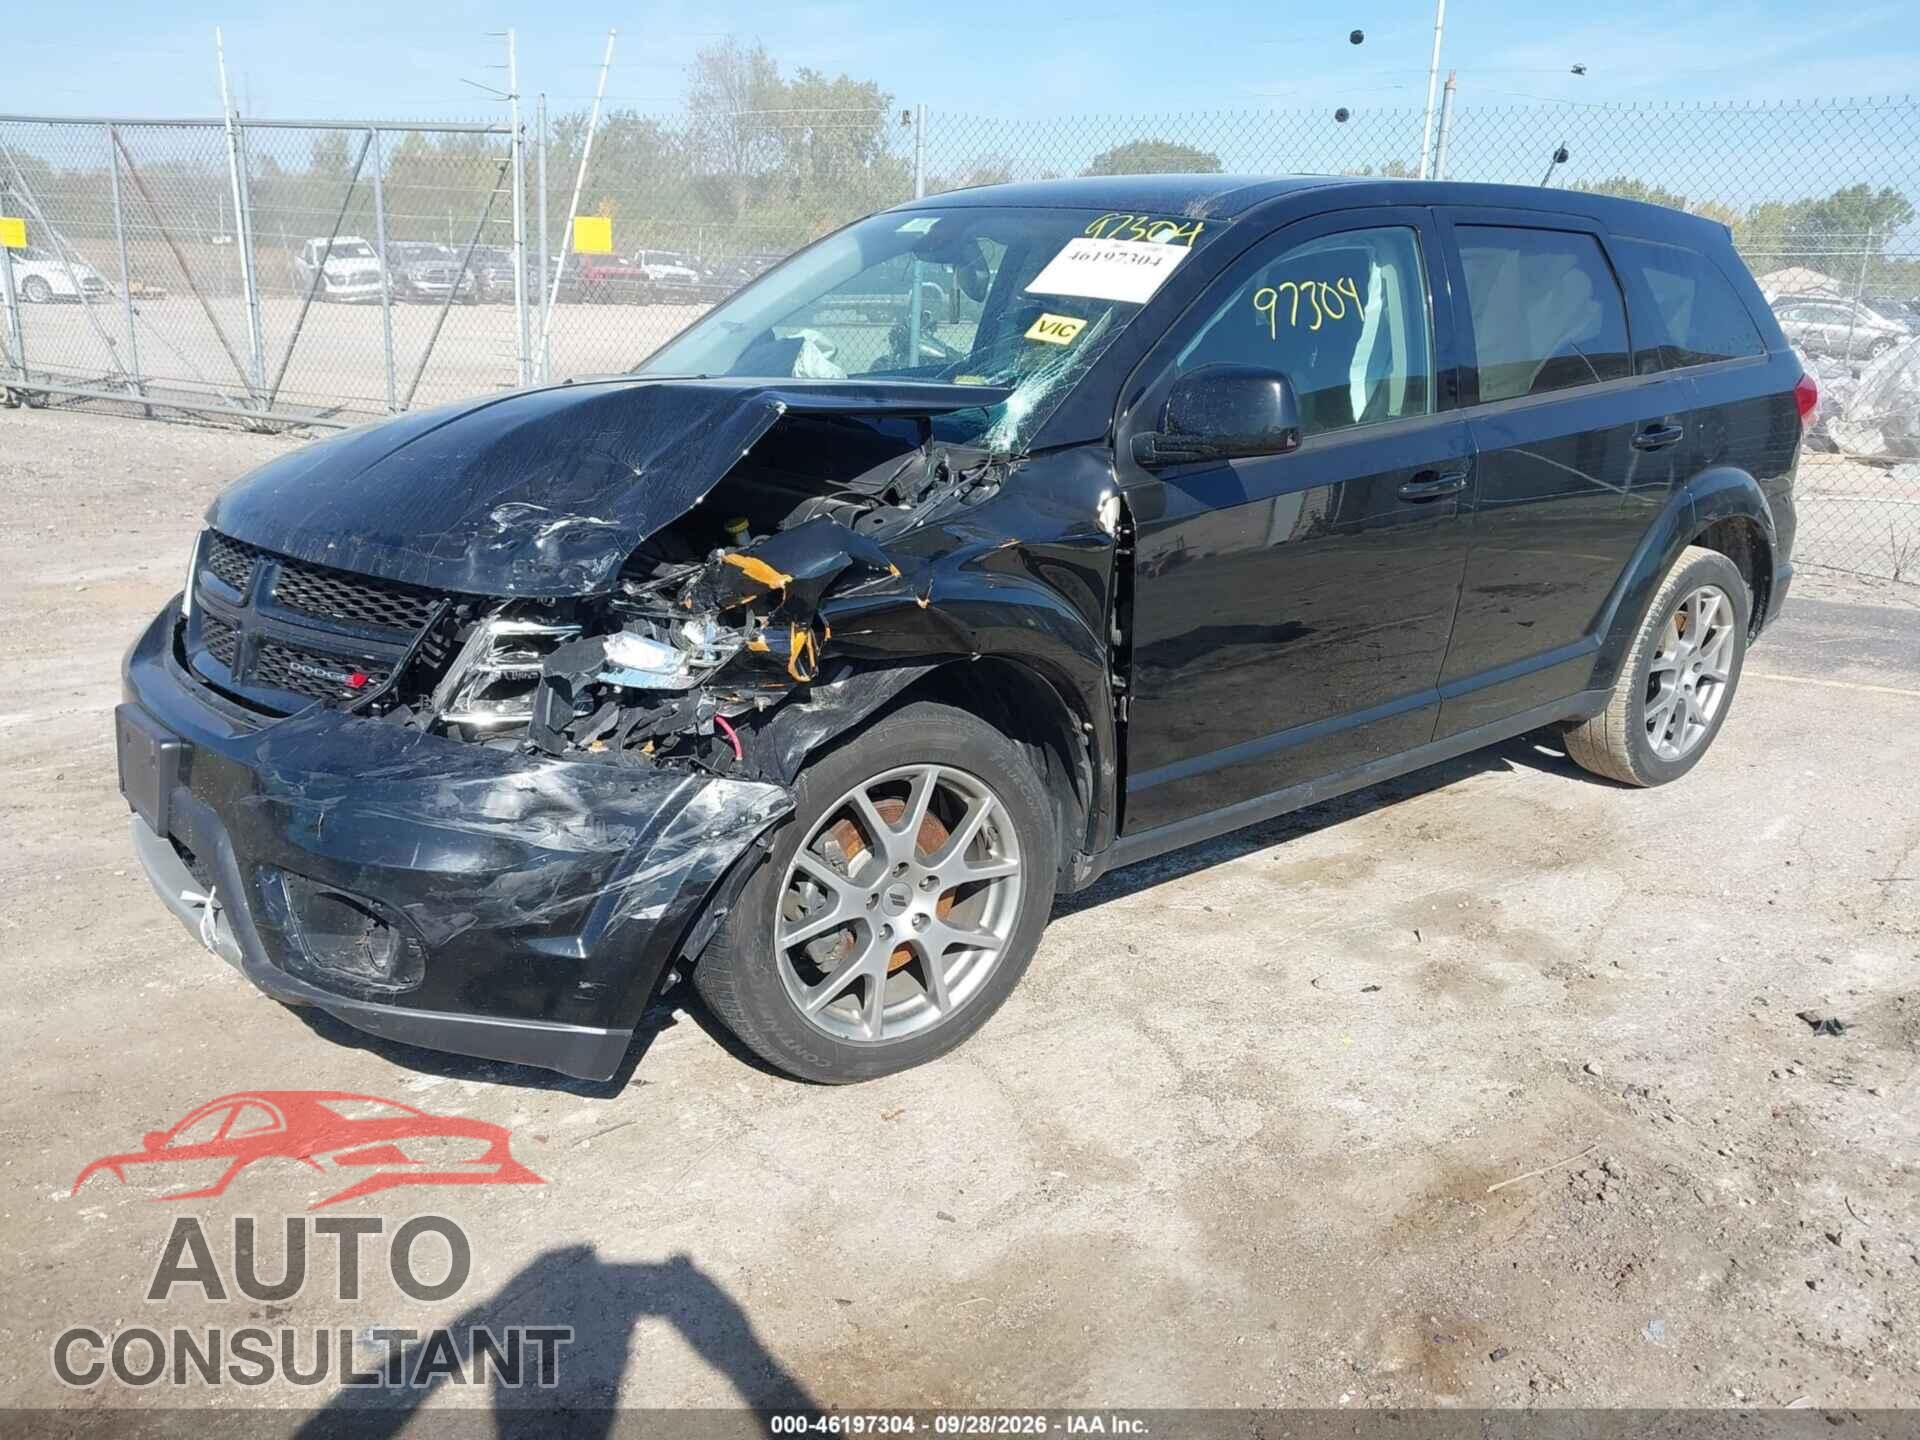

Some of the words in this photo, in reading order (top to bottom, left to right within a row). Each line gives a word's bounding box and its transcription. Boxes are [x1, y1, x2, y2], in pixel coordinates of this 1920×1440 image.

[1084, 213, 1204, 246] 97304
[1069, 250, 1163, 267] 46197304
[1253, 277, 1366, 341] 97304
[1037, 318, 1077, 338] VIC
[290, 662, 346, 681] DODGE
